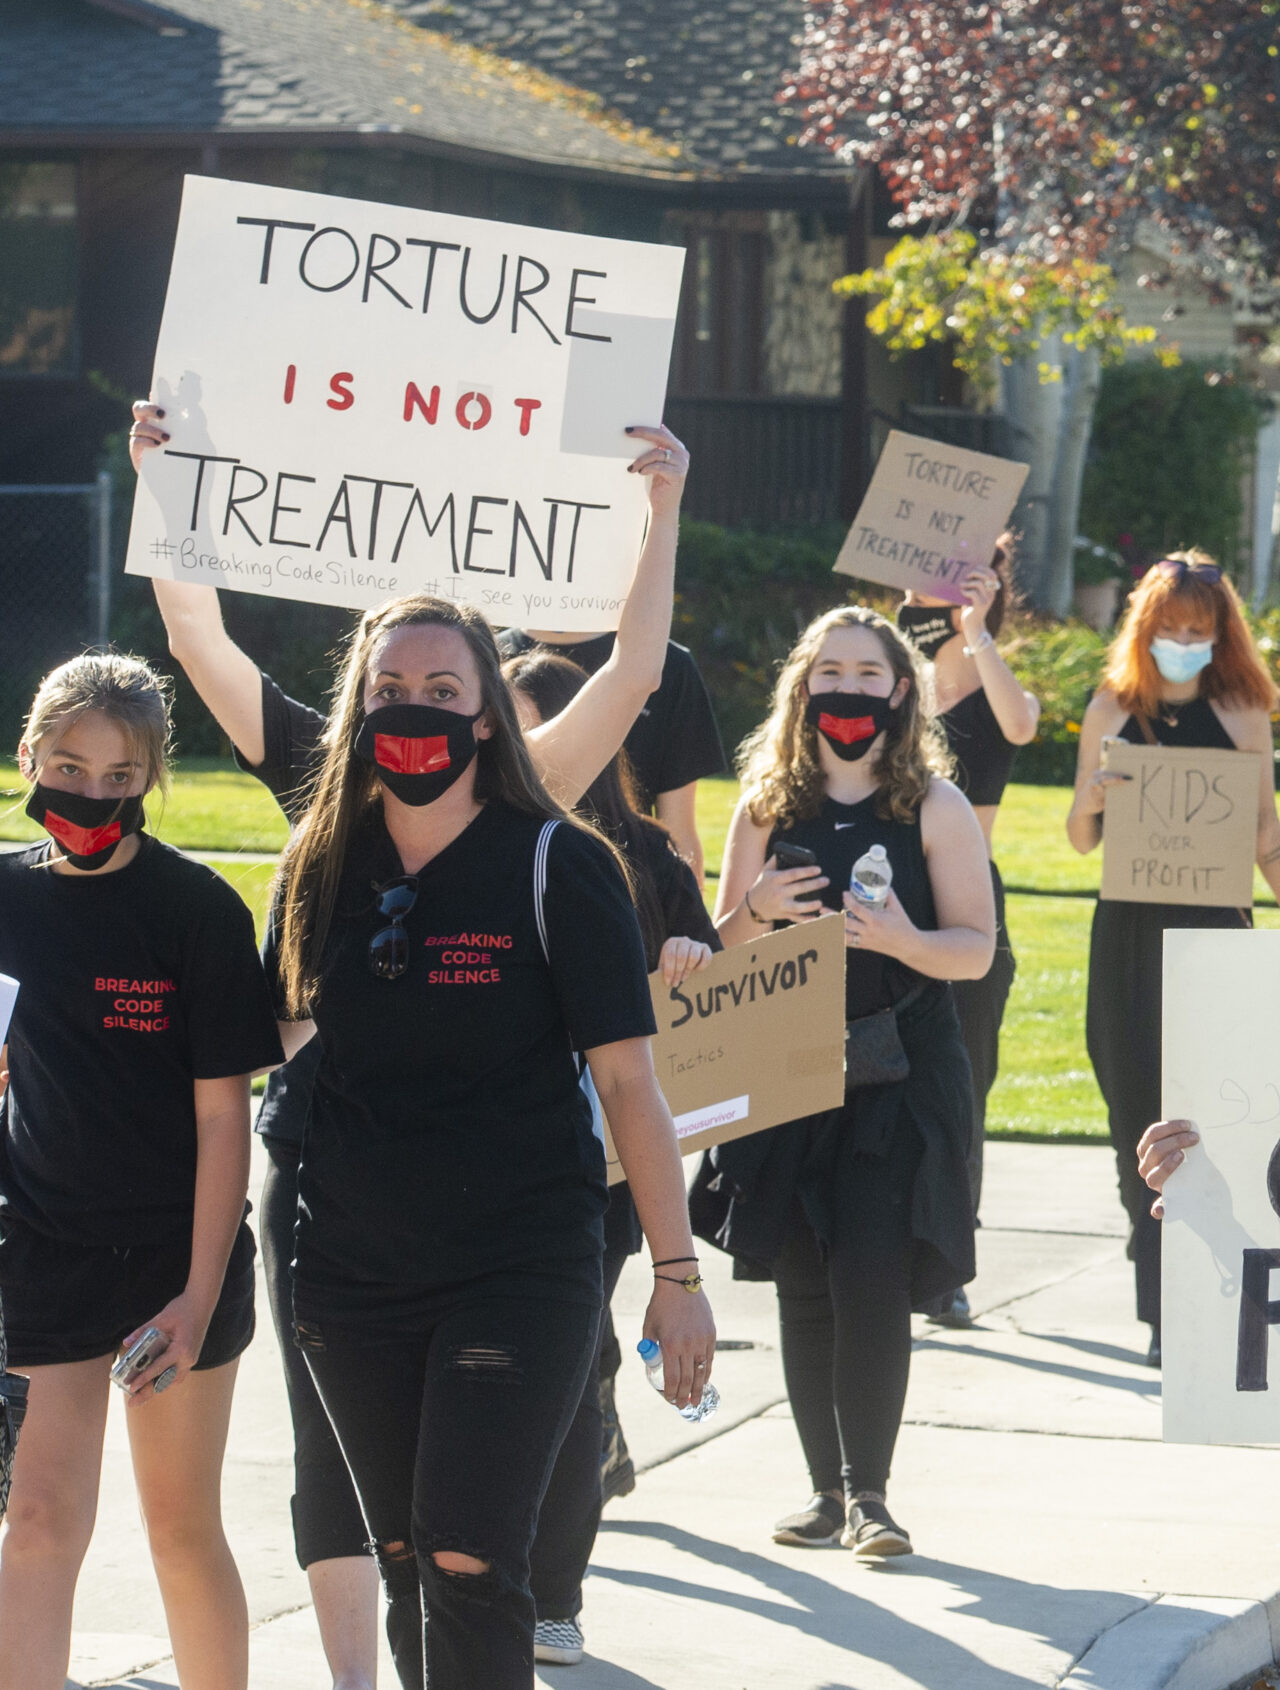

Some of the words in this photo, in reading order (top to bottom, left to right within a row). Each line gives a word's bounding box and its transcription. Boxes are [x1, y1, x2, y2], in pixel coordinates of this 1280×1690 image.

[237, 216, 613, 345] TORTURE
[284, 364, 355, 412] IS
[403, 381, 542, 436] NOT
[905, 451, 997, 500] TORTURE
[164, 450, 611, 584] TREATMENT
[895, 499, 914, 520] IS
[928, 510, 965, 536] NOT
[856, 526, 969, 584] TREATMENT
[149, 537, 398, 592] #BreakingCodeSilence
[481, 588, 513, 608] see
[522, 593, 551, 616] you
[559, 594, 632, 612] survivor
[1138, 763, 1235, 830] KIDS
[1149, 833, 1194, 851] OVER
[1131, 857, 1227, 894] PROFIT
[424, 932, 513, 949] BREAKING
[441, 950, 492, 964] CODE
[428, 968, 501, 984] SILENCE
[670, 948, 818, 1029] Survivor
[103, 1015, 170, 1033] SILENCE
[113, 998, 163, 1013] CODE
[667, 1046, 724, 1078] Tactics
